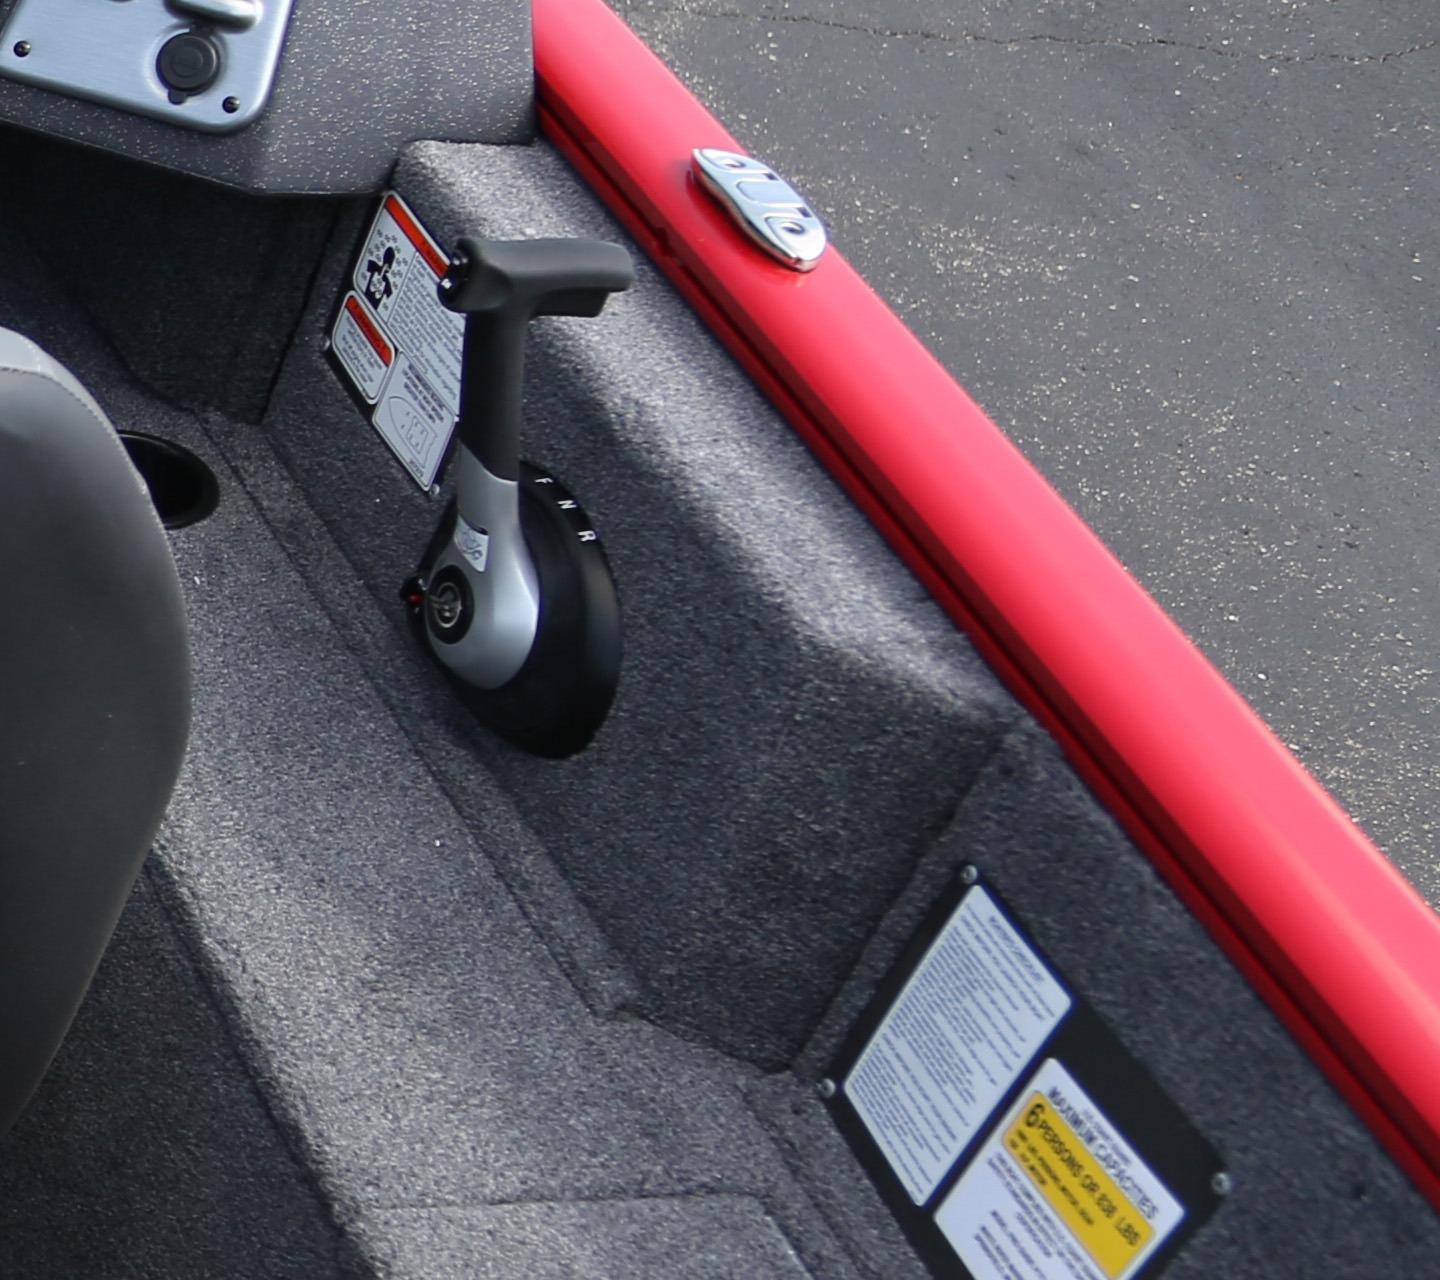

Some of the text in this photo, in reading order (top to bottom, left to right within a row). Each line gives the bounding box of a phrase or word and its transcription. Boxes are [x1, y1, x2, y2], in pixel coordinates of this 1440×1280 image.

[558, 499, 577, 510] N
[578, 530, 597, 542] R
[1025, 1103, 1045, 1128] 6
[1038, 1119, 1084, 1178] PERSONS
[1047, 1086, 1097, 1145] MAXIMUM
[1094, 1143, 1160, 1220] CAPACITIES
